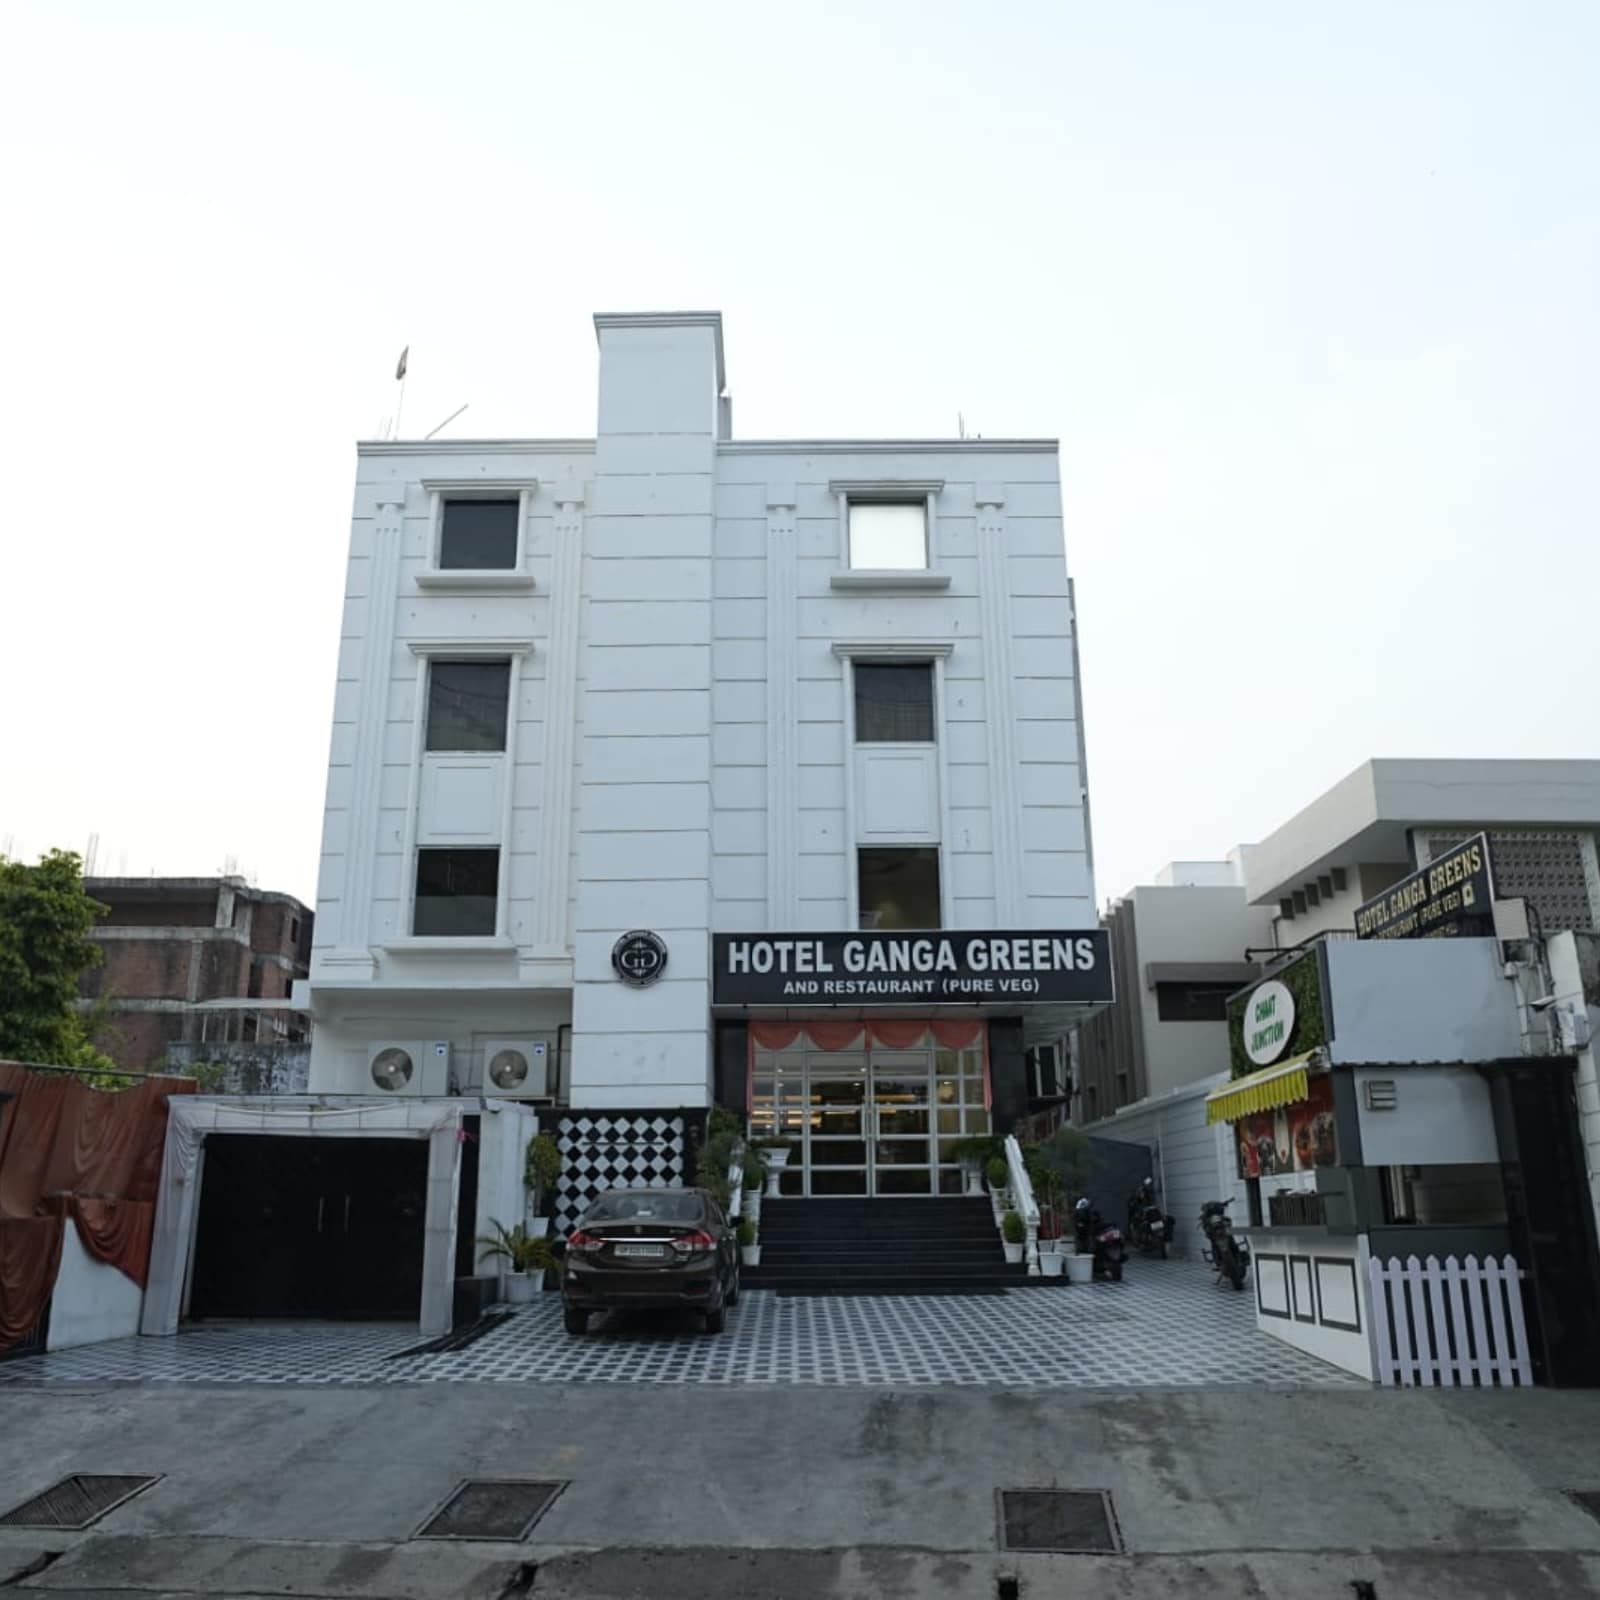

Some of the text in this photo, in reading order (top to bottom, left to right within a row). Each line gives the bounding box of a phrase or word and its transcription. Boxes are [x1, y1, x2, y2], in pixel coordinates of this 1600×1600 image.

[1358, 900, 1390, 936] HOTEL
[1390, 878, 1427, 918] GANGA
[1429, 845, 1481, 896] GREENS
[728, 938, 1095, 973] HOTEL GANGA GREENS
[783, 978, 1040, 994] AND RESTAURANT (PURE VEG)
[1251, 1020, 1284, 1053] JUNCTION
